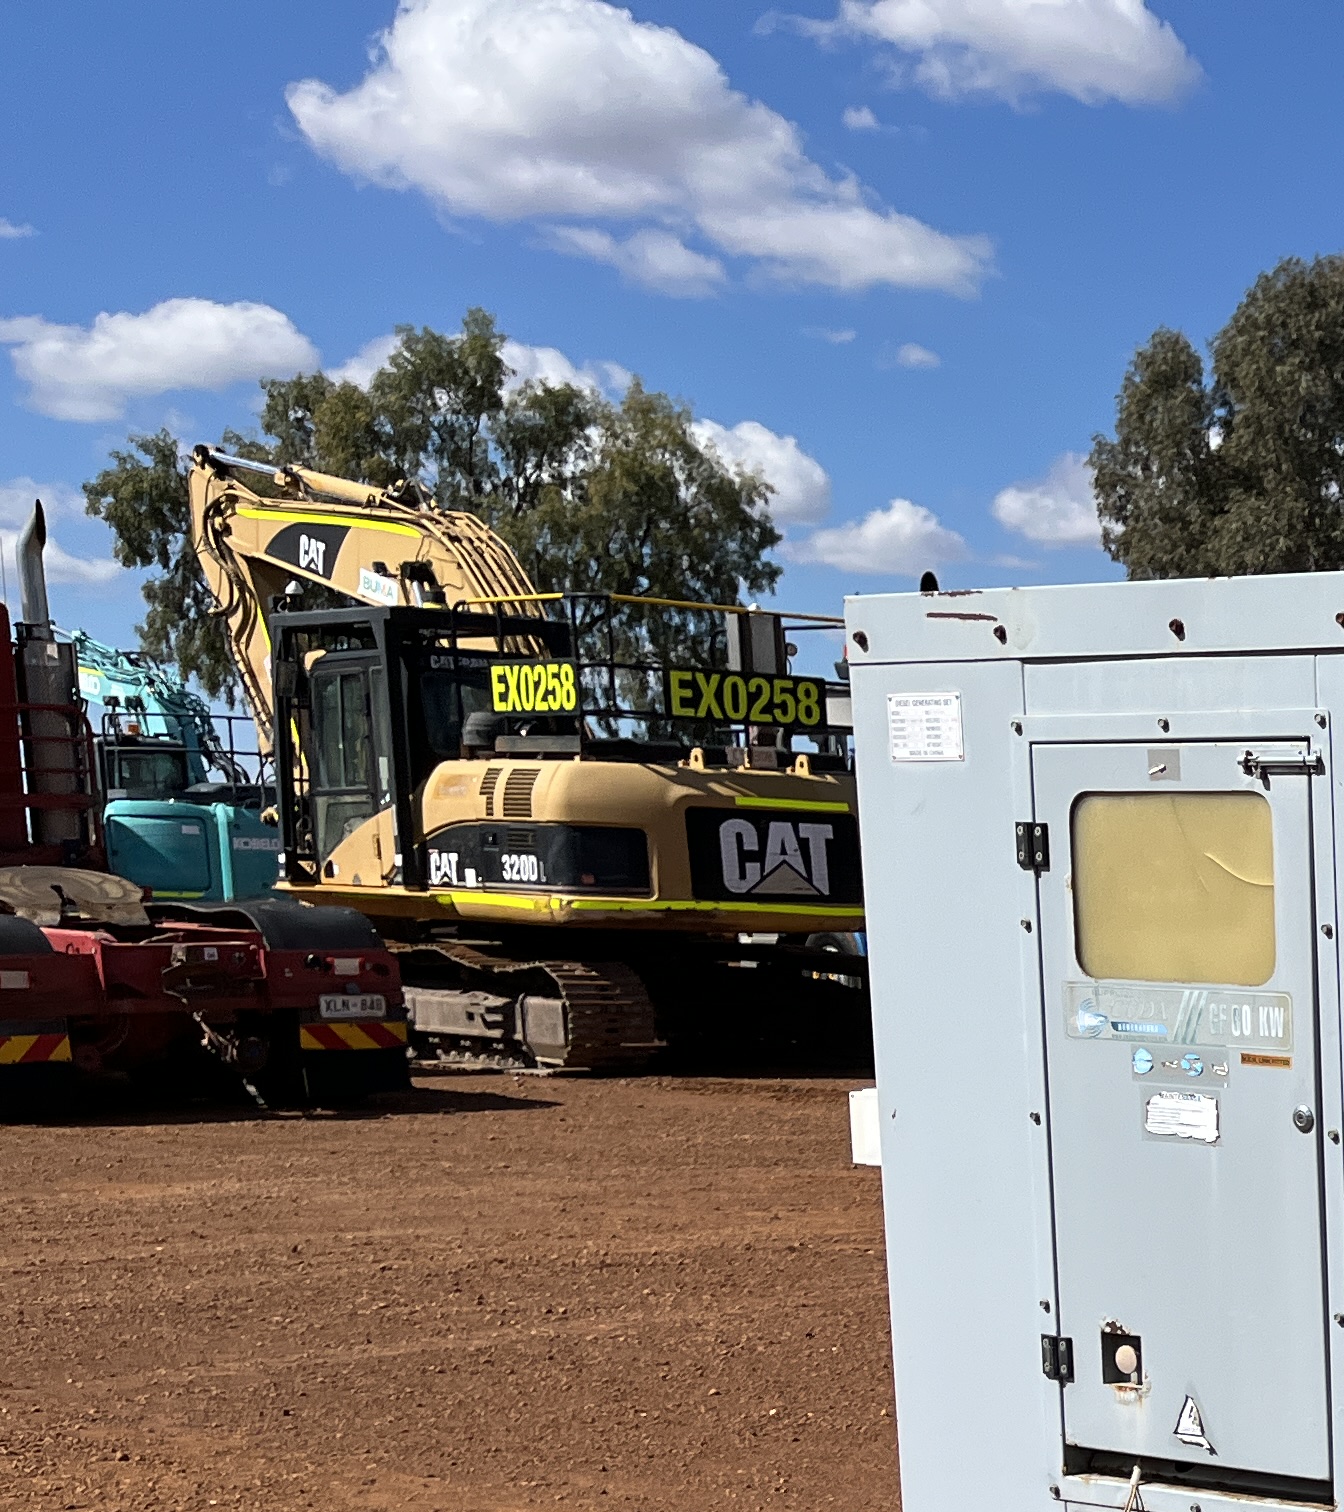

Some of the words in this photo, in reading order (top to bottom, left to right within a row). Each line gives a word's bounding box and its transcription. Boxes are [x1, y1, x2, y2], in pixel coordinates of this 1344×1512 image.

[299, 534, 326, 575] CAT
[490, 663, 576, 712] EX0258
[669, 669, 821, 726] EX0258
[429, 852, 458, 885] CAT
[501, 854, 538, 882] 320D
[718, 818, 834, 896] CAT
[1258, 1006, 1285, 1038] KW
